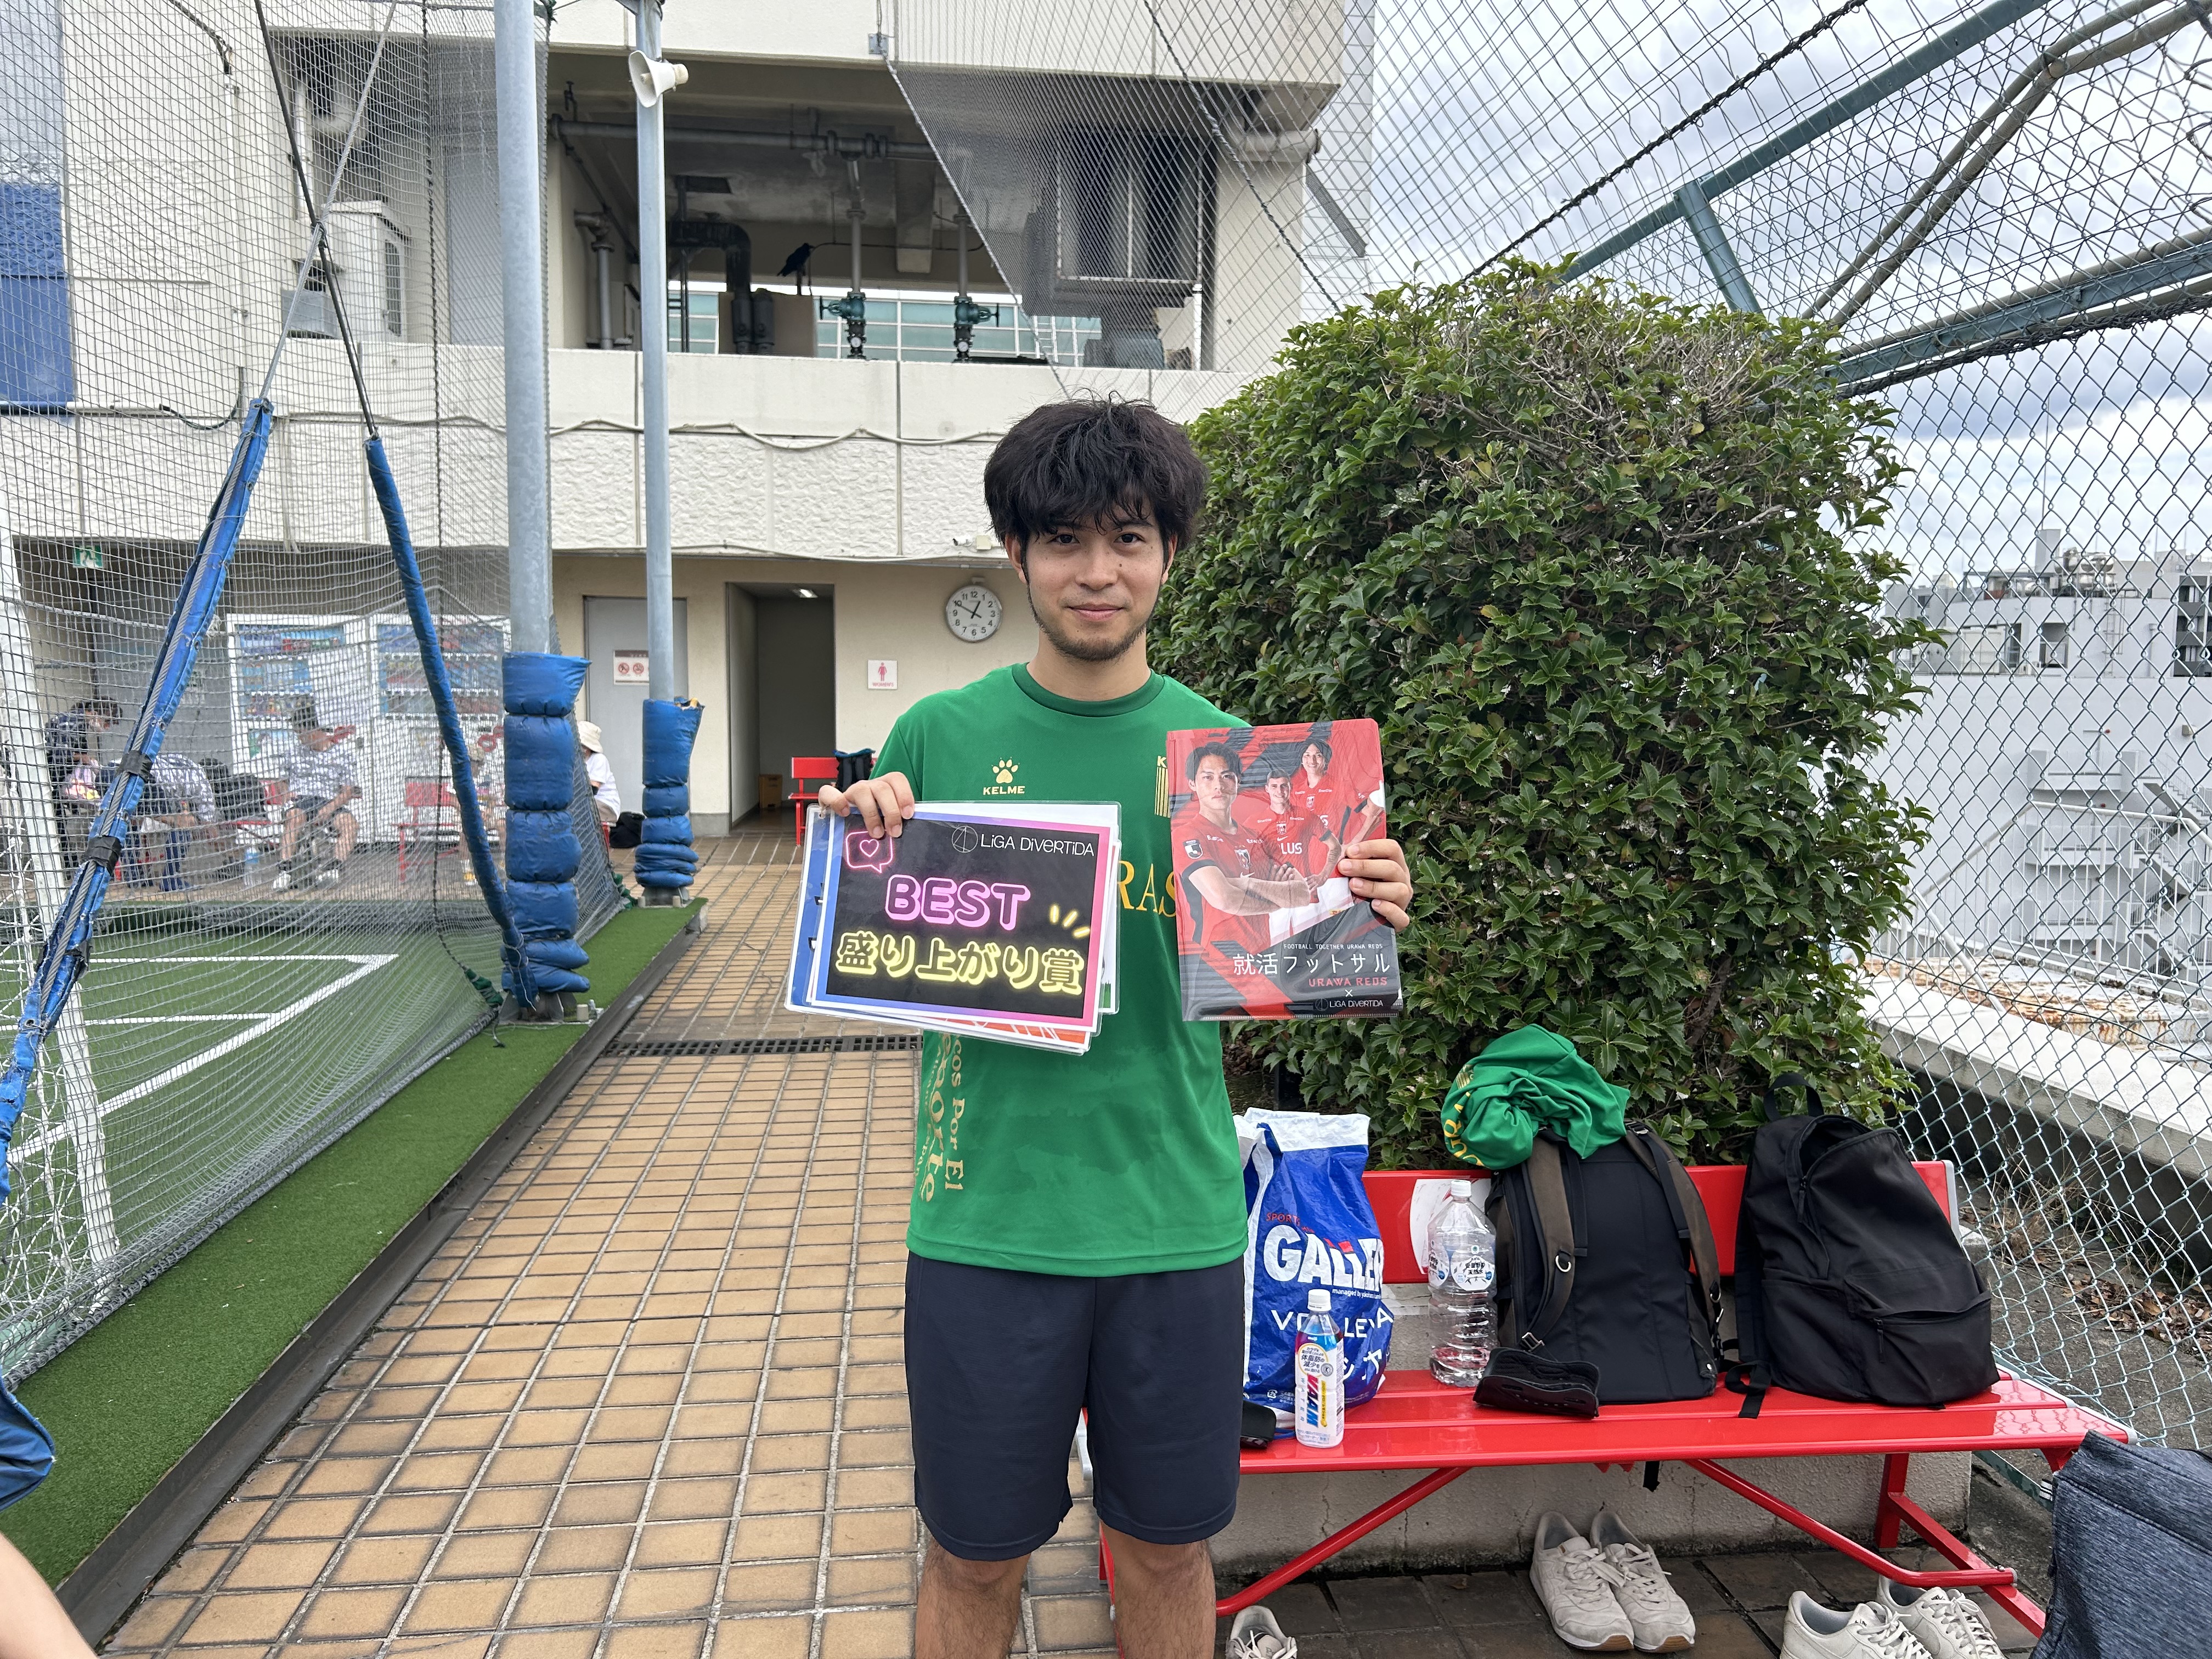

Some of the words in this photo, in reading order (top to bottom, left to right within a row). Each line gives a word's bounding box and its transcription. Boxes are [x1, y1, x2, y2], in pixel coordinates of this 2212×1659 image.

[983, 786, 1025, 795] KELME
[884, 874, 1031, 931] BEST
[835, 930, 1085, 996] 盛り上がり賞
[1232, 952, 1390, 975] 就活フットサル
[1308, 977, 1351, 987] URAWA
[1356, 977, 1387, 986] REDS
[950, 1097, 966, 1150] Por
[945, 1158, 964, 1190] El
[1332, 1289, 1357, 1297] managed
[1307, 1373, 1319, 1428] VAAM
